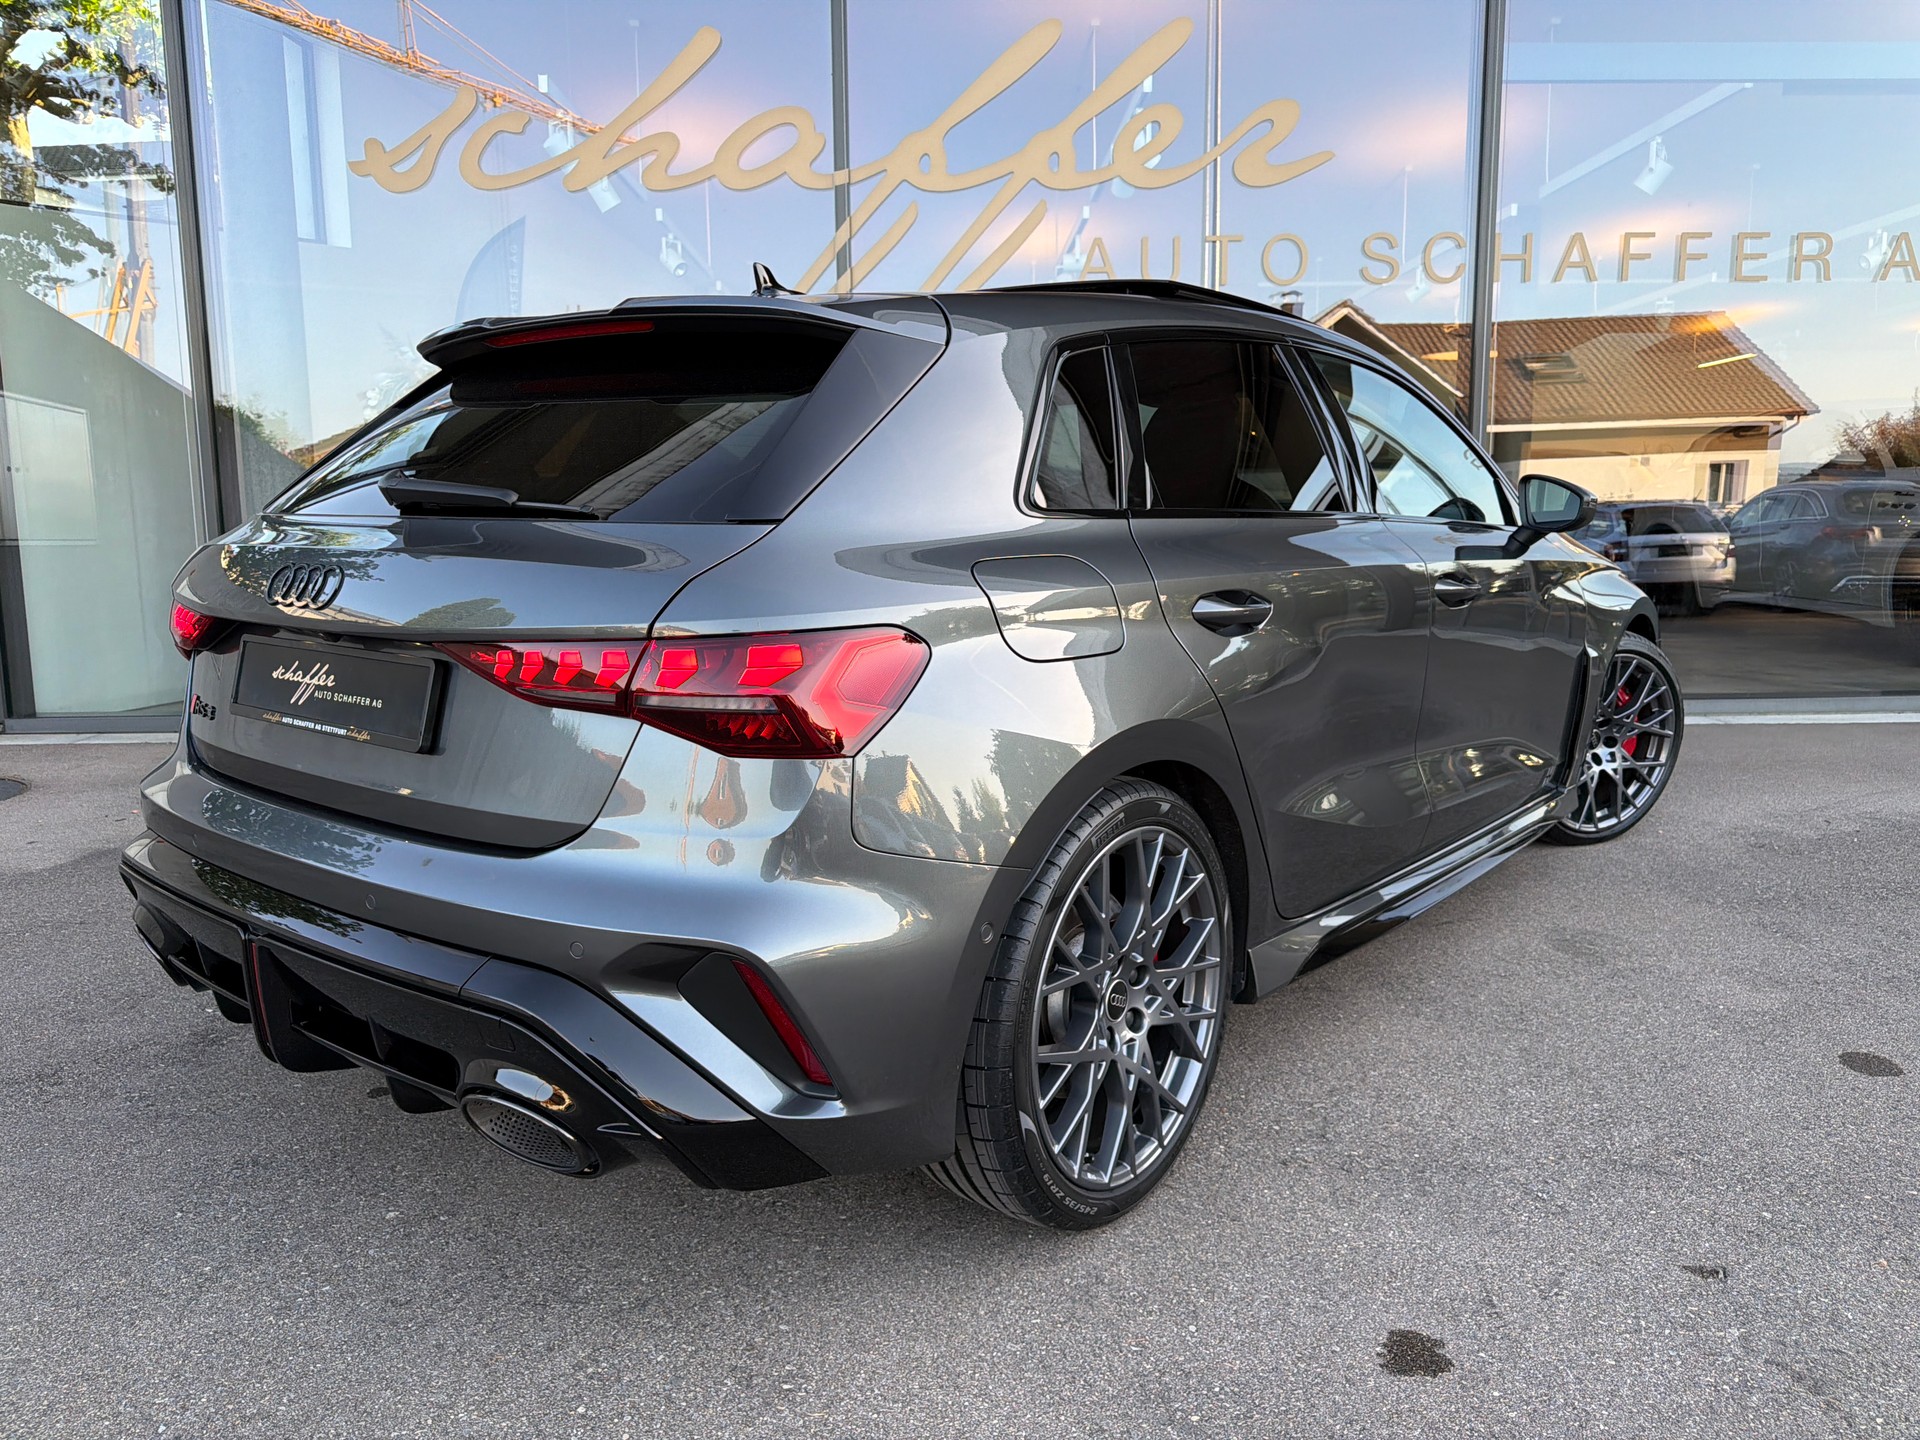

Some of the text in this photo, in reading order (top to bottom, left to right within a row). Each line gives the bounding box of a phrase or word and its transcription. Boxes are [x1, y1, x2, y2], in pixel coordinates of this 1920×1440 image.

[1079, 233, 1310, 286] AUTO
[1360, 231, 1834, 285] SCHAFFER
[271, 660, 336, 705] schaffer
[313, 690, 383, 708] AUTO SCHAFFER AG
[281, 716, 293, 725] AUTO
[293, 718, 315, 729] SCHAFFER
[322, 724, 348, 736] STETTFURT
[1063, 1196, 1098, 1215] 245/35
